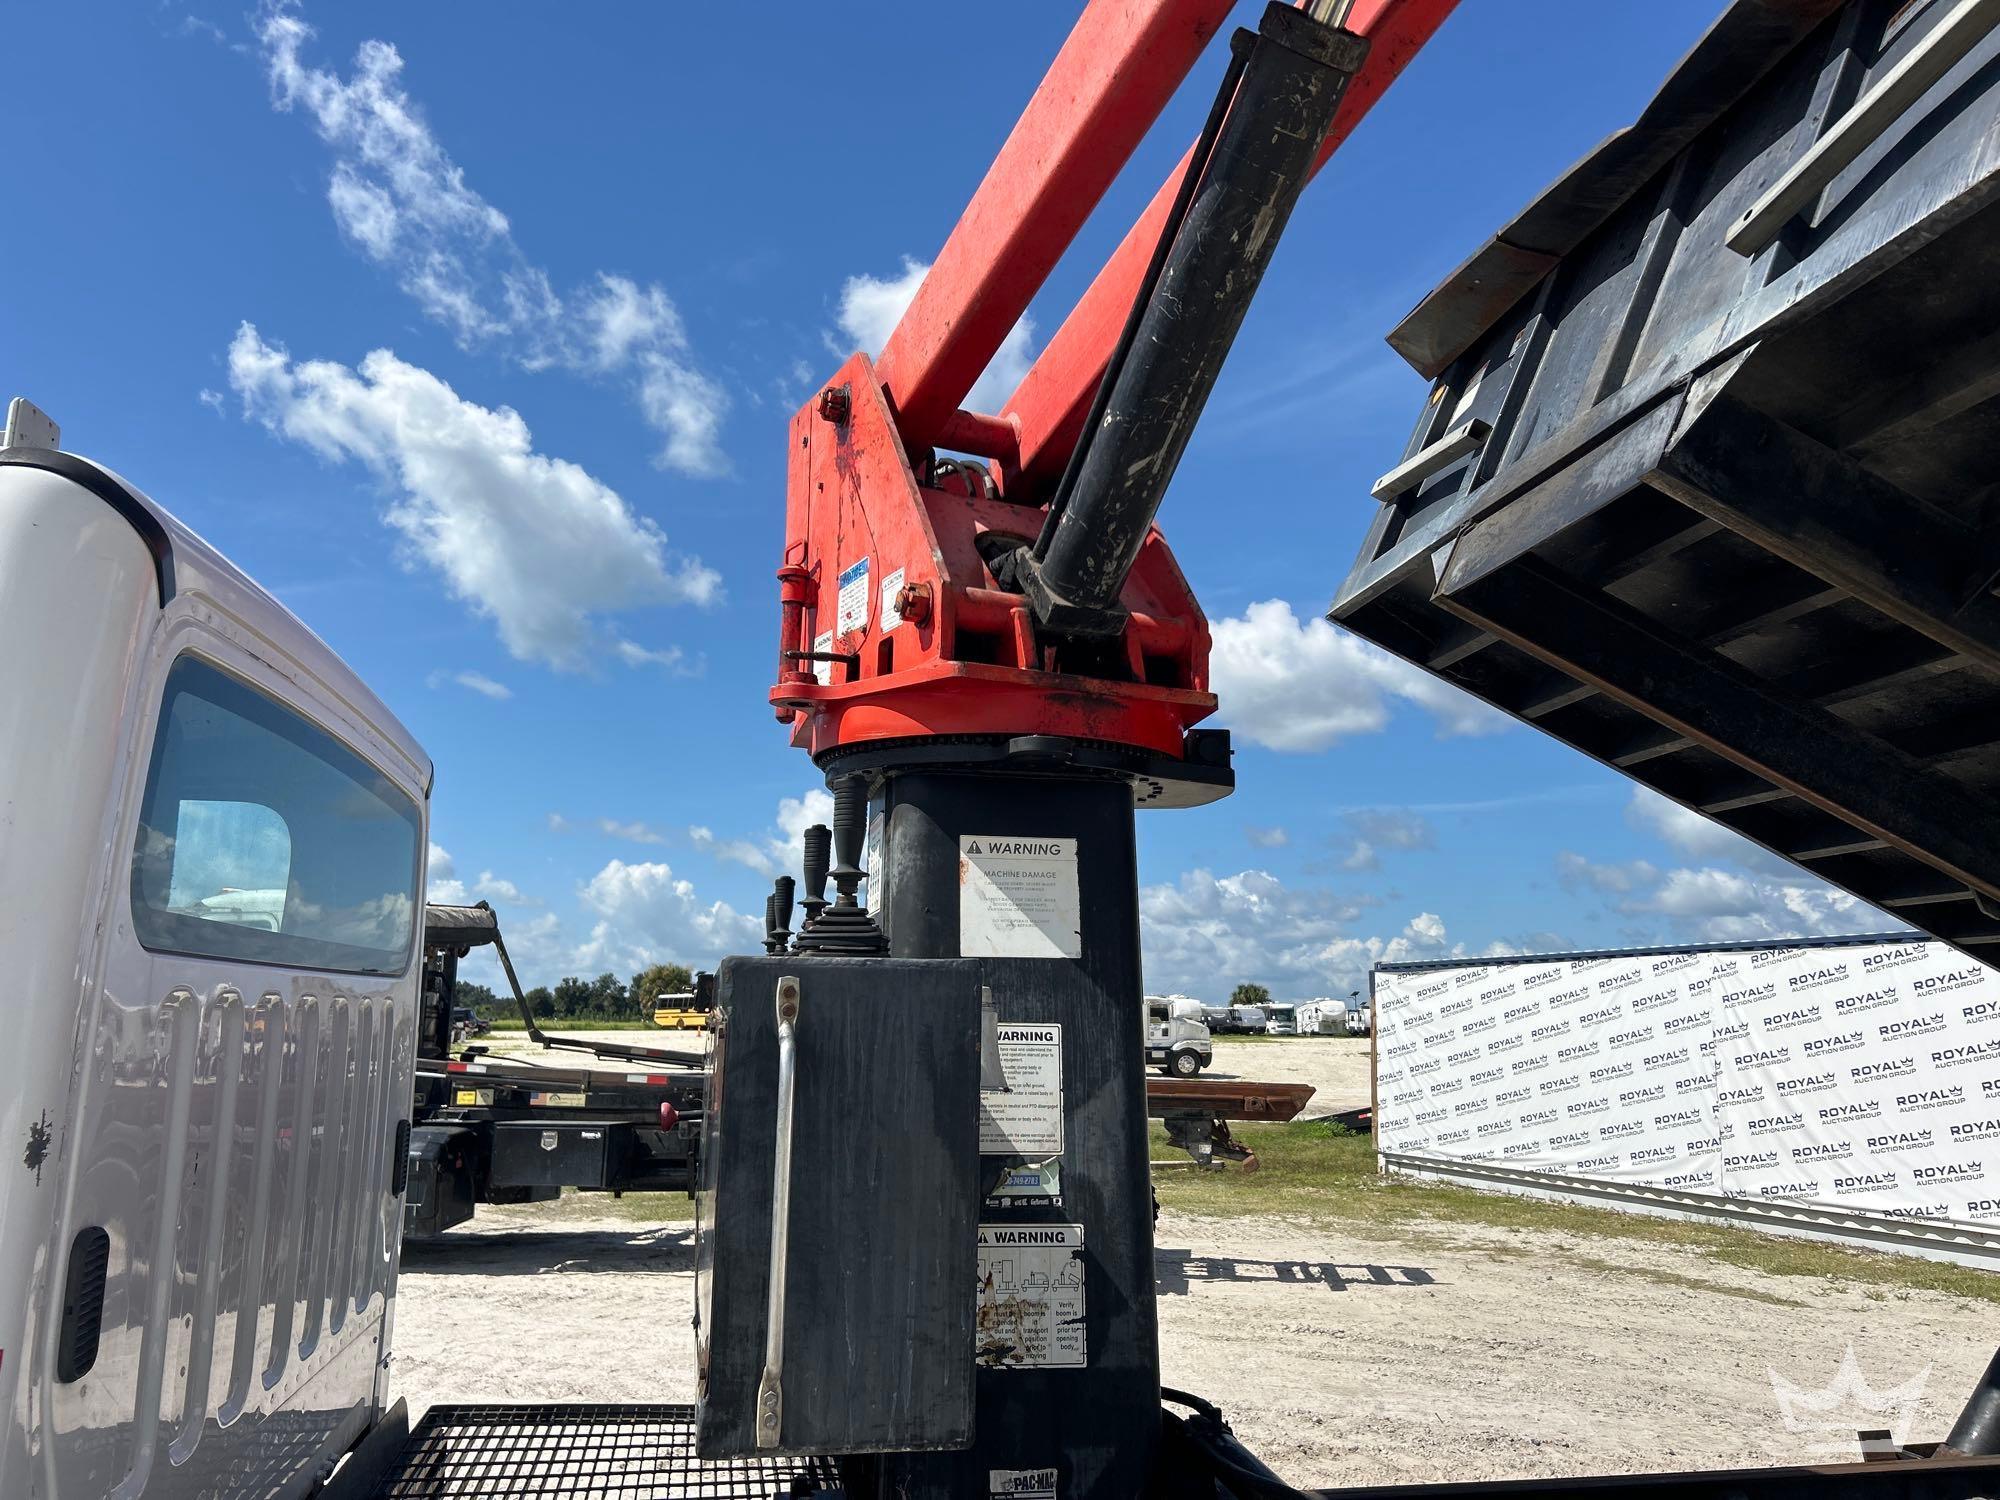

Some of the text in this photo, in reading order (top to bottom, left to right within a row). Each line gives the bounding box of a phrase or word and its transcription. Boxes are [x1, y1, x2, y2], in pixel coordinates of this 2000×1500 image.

[988, 842, 1061, 856] WARNING
[1022, 871, 1057, 879] DAMAGE
[1652, 955, 1688, 972] ROYAL
[1863, 948, 1913, 967] ROYAL
[1866, 954, 1929, 974] AUCTION GROUP
[1456, 970, 1481, 984] ROYAL
[1524, 970, 1554, 985] ROYAL
[1599, 973, 1632, 989] ROYAL
[1789, 968, 1835, 986] ROYAL
[1792, 975, 1849, 992] AUCTION GROUP
[1914, 971, 1968, 990] ROYAL
[1417, 984, 1440, 998] ROYAL
[1481, 986, 1507, 1000] ROYAL
[1917, 978, 1984, 997] AUCTION GROUP
[1549, 990, 1580, 1004] ROYAL
[1632, 992, 1668, 1008] ROYAL
[1722, 987, 1764, 1003] ROYAL
[1724, 993, 1776, 1009] AUCTION GROUP
[1835, 992, 1884, 1009] ROYAL
[1382, 997, 1403, 1010] ROYAL
[1838, 998, 1898, 1016] AUCTION GROUP
[1963, 1001, 2000, 1017] ROY
[1504, 1005, 1532, 1019] ROYAL
[1580, 1008, 1612, 1024] ROYAL
[1764, 1010, 1808, 1026] ROYAL
[1404, 1014, 1426, 1026] ROYAL
[1462, 1018, 1488, 1032] ROYAL
[1664, 1014, 1700, 1029] ROYAL
[1766, 1016, 1822, 1032] AUCTION GROUP
[1879, 1018, 1931, 1035] ROYAL
[1532, 1024, 1561, 1038] ROYAL
[1609, 1029, 1643, 1044] ROYAL
[1882, 1025, 1947, 1042] AUCTION GROUP
[1488, 1037, 1515, 1050] ROYAL
[1804, 1035, 1851, 1051] ROYAL
[1806, 1042, 1865, 1058] AUCTION GROUP
[1448, 1050, 1473, 1062] ROYAL
[1558, 1044, 1590, 1058] ROYAL
[1644, 1051, 1679, 1065] ROYAL
[1735, 1050, 1778, 1065] ROYAL
[1932, 1044, 1987, 1061] ROYAL
[1410, 1061, 1434, 1073] ROYAL
[1512, 1057, 1540, 1070] ROYAL
[1851, 1061, 1902, 1077] ROYAL
[1935, 1058, 1972, 1069] AUCTION
[1470, 1069, 1496, 1082] ROYAL
[1590, 1065, 1623, 1079] ROYAL
[1540, 1078, 1571, 1091] ROYAL
[1676, 1074, 1712, 1089] ROYAL
[1777, 1076, 1824, 1090] ROYAL
[1496, 1089, 1524, 1102] ROYAL
[1620, 1088, 1655, 1101] ROYAL
[1720, 1089, 1752, 1100] OYAL
[1780, 1084, 1837, 1097] AUCTION GROUP
[1896, 1090, 1949, 1106] ROYAL
[1455, 1101, 1481, 1112] ROYAL
[1568, 1100, 1600, 1112] ROYAL
[1819, 1104, 1866, 1118] ROYAL
[1900, 1098, 1965, 1113] AUCTION GROUP
[1380, 1119, 1402, 1129] ROYAL
[1520, 1111, 1549, 1123] ROYAL
[1655, 1111, 1691, 1125] ROYAL
[1748, 1116, 1792, 1129] ROYAL
[1822, 1112, 1881, 1125] AUCTION GROUP
[1478, 1121, 1504, 1133] ROYAL
[1600, 1123, 1634, 1135] ROYAL
[1549, 1133, 1581, 1145] ROYAL
[1867, 1133, 1918, 1147] ROYAL
[1504, 1144, 1532, 1154] ROYAL
[1630, 1148, 1665, 1160] ROYAL
[1792, 1144, 1839, 1157] ROYAL
[1870, 1141, 1934, 1154] AUCTION GROUP
[1577, 1157, 1610, 1168] ROYAL
[1724, 1154, 1766, 1166] ROYAL
[1795, 1152, 1853, 1164] AUCTION GROUP
[1914, 1164, 1968, 1178] ROYAL
[1665, 1173, 1703, 1185] ROYAL
[1835, 1175, 1883, 1188] ROYAL
[1916, 1174, 1984, 1186] AUCTION GROUP
[1761, 1184, 1806, 1195] ROYAL
[1837, 1187, 1870, 1195] AUCTION
[1968, 1200, 2000, 1211] ROY
[994, 1231, 1066, 1244] WARNING
